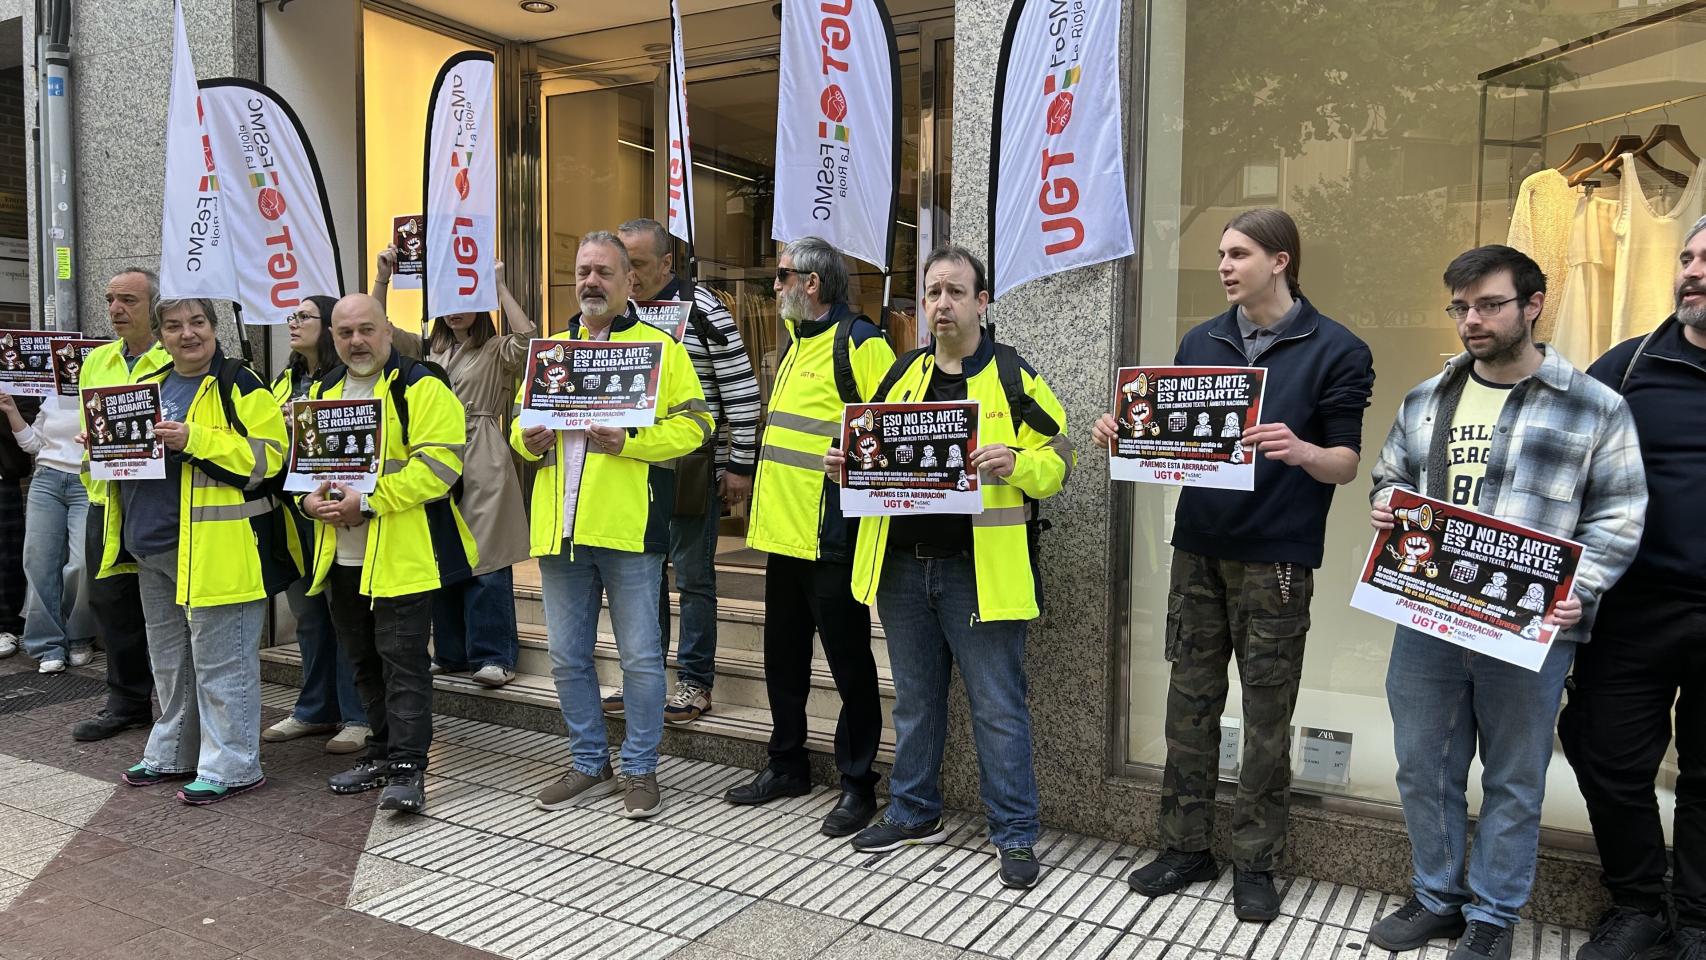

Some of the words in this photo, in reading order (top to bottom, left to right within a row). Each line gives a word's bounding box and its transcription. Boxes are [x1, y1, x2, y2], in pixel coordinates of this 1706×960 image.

[1071, 0, 1086, 38] Rioja
[1038, 148, 1085, 256] UGT
[648, 306, 658, 314] ES
[574, 349, 593, 359] ESO
[595, 349, 609, 358] NO
[611, 348, 623, 357] ES
[625, 347, 653, 357] ARTE,
[573, 359, 590, 367] ES
[593, 357, 652, 366] ROBARTE.
[1157, 379, 1178, 391] ESO
[1180, 378, 1195, 390] NO
[1197, 377, 1213, 390] ES
[1214, 375, 1251, 390] ARTE,
[106, 396, 117, 406] ESO
[118, 394, 126, 404] NO
[127, 392, 134, 403] ES
[135, 389, 153, 402] ARTE,
[1157, 392, 1175, 402] ES
[1178, 389, 1249, 401] ROBARTE.
[107, 406, 117, 415] ES
[118, 400, 154, 413] ROBARTE.
[317, 410, 330, 420] ESO
[331, 408, 342, 418] NO
[343, 407, 354, 417] ES
[355, 405, 377, 417] ARTE,
[318, 420, 329, 428] ES
[331, 416, 377, 427] ROBARTE.
[883, 414, 902, 426] ESO
[904, 413, 918, 425] NO
[920, 412, 933, 424] ES
[936, 410, 967, 423] ARTE,
[884, 427, 899, 436] ES
[903, 422, 967, 435] ROBARTE.
[1447, 446, 1490, 468] EAG
[1140, 460, 1166, 469] ¡PAREMOS
[1168, 462, 1181, 470] ESTA
[1182, 462, 1219, 472] ABERRACIÓN!
[1154, 471, 1172, 480] UGT
[911, 491, 946, 499] ABERRACIÓN!
[884, 500, 902, 508] UGT
[1444, 518, 1476, 538] ESO
[1474, 526, 1498, 544] NO
[1497, 532, 1520, 550] ES
[1519, 540, 1561, 564] ARTE,
[1442, 532, 1468, 548] ES
[1469, 540, 1563, 574] ROBARTE.
[1440, 544, 1462, 555] SECTOR
[1460, 550, 1489, 562] COMERCIO
[1488, 557, 1506, 567] TEXTIL
[1509, 562, 1531, 574] ÁMBITO
[1531, 569, 1560, 582] NACIONAL
[1375, 571, 1398, 583] derechos
[1405, 581, 1426, 593] festivos
[1429, 590, 1460, 605] precariedad
[1460, 600, 1473, 609] para
[1472, 604, 1482, 612] los
[1481, 607, 1502, 619] nuevos
[1382, 567, 1398, 577] nuevo
[1398, 572, 1427, 587] preacuerdo
[1426, 582, 1436, 590] del
[1435, 585, 1453, 596] sector
[1459, 593, 1467, 601] un
[1507, 610, 1517, 618] de
[1411, 589, 1419, 597] es
[1396, 598, 1434, 616] ¡PAREMOS
[1434, 610, 1453, 623] ESTA
[1452, 617, 1503, 640] ABERRACIÓN!
[1411, 614, 1438, 631] UGT
[1454, 628, 1477, 641] FeSMC
[1318, 730, 1334, 740] ZARA
